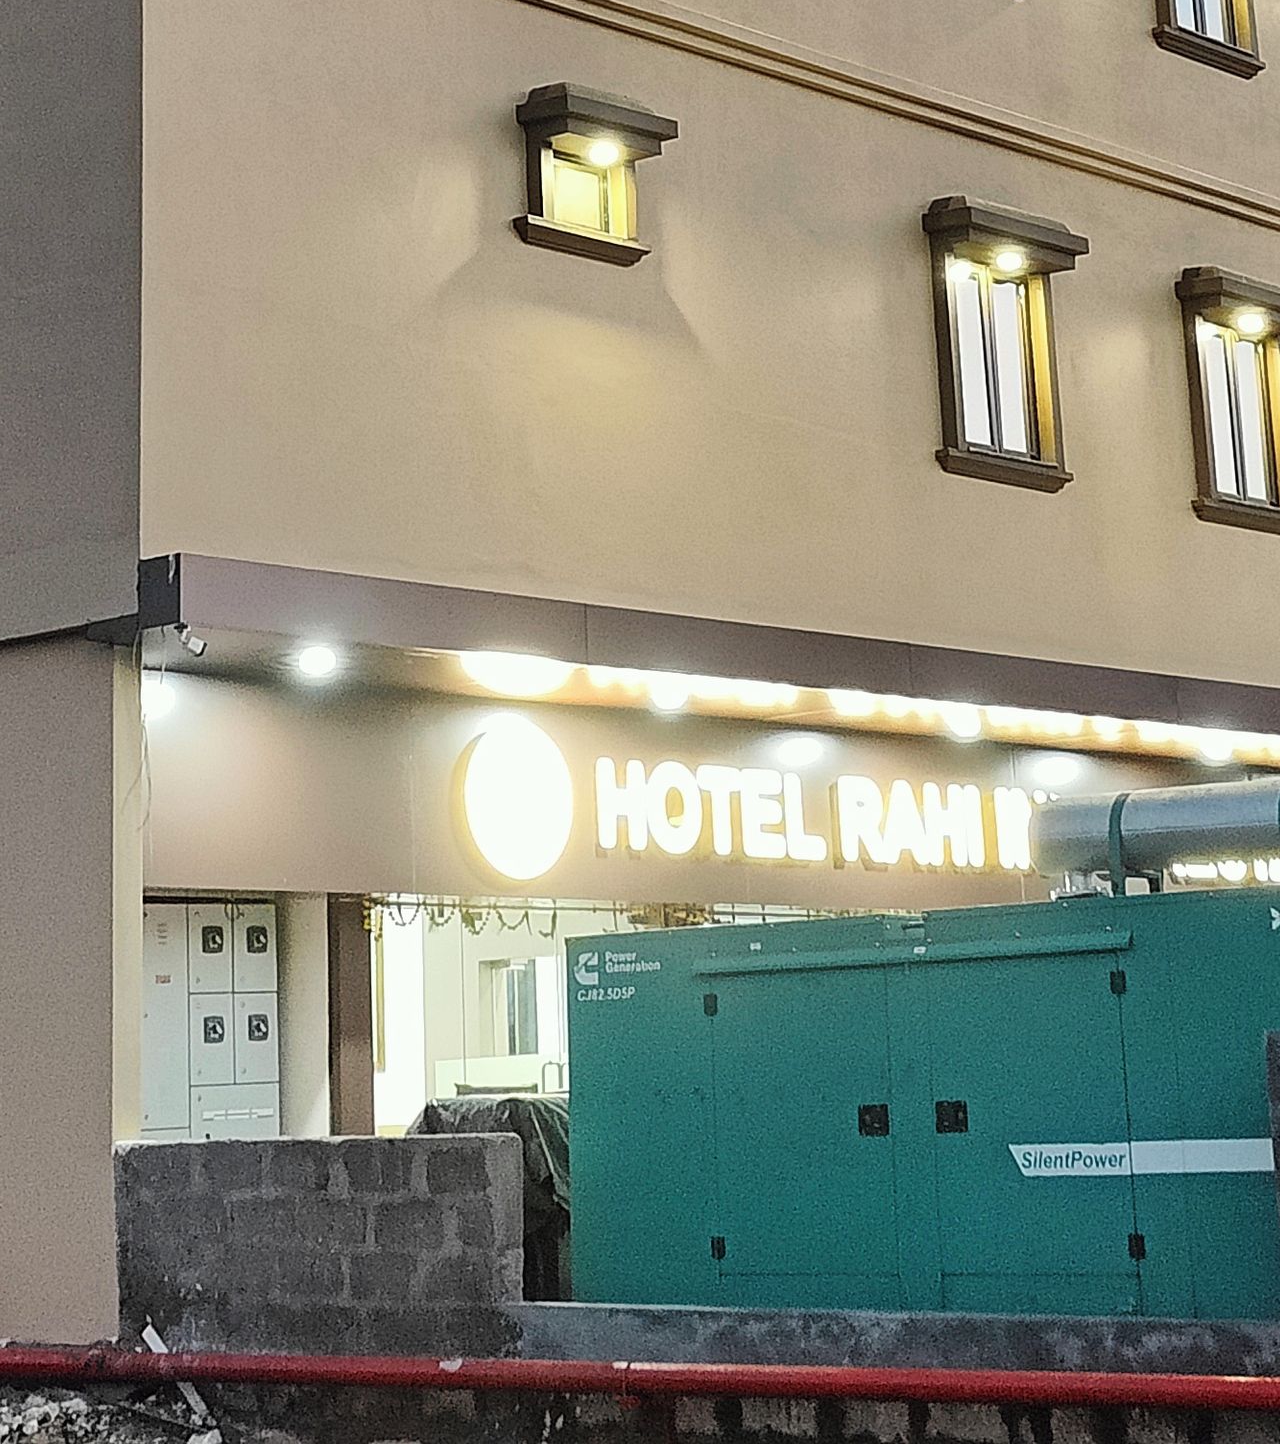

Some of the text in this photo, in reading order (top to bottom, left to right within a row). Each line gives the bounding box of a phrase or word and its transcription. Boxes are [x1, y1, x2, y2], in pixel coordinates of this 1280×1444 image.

[595, 756, 828, 861] HOTEL
[837, 774, 985, 868] RAHI
[605, 951, 637, 962] Power
[1021, 1150, 1126, 1169] SilentPower
